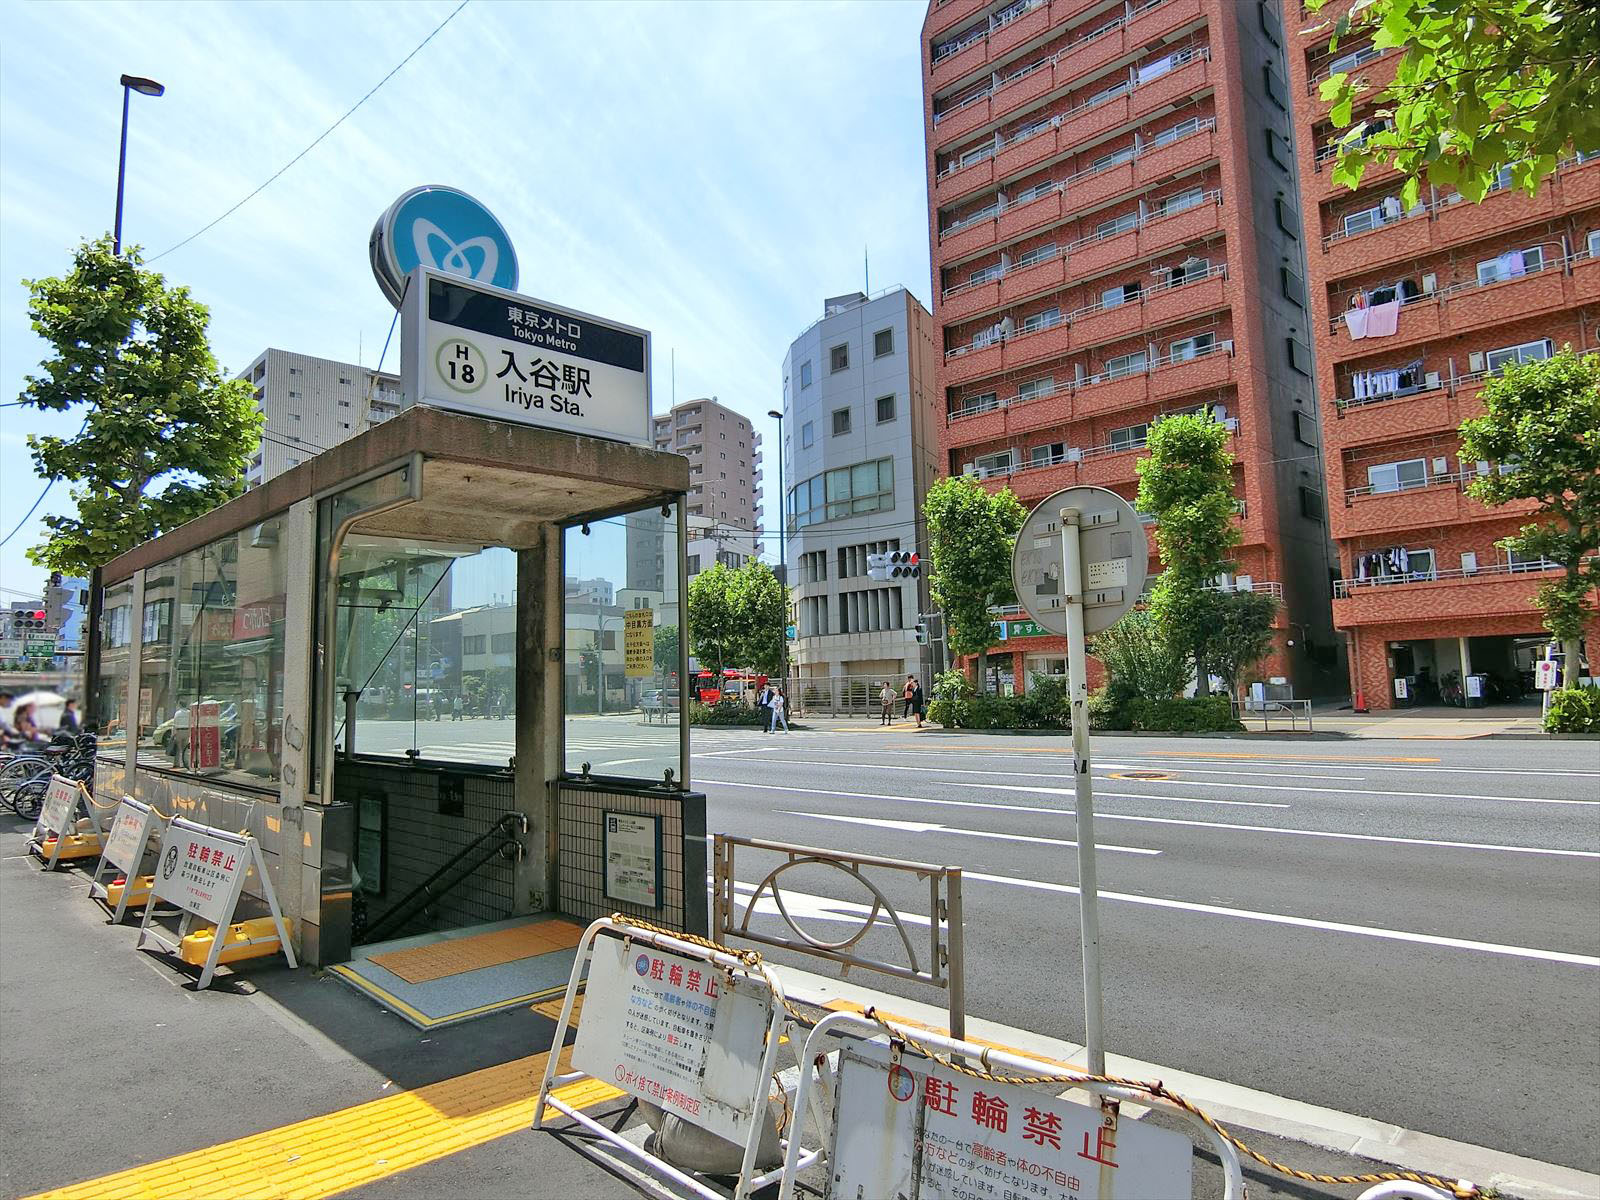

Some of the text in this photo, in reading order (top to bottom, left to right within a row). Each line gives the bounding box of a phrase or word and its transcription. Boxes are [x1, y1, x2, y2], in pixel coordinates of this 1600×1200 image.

[507, 306, 582, 339] 東京メトロ
[512, 325, 577, 352] Tokyo Metro
[456, 344, 469, 361] H
[448, 361, 476, 384] 18
[496, 349, 593, 399] 入谷駅
[505, 383, 585, 418] Iriya Sta.
[187, 842, 236, 872] 駐輪禁止
[649, 958, 719, 999] 駐輪禁止
[924, 1076, 1119, 1169] 駐輪禁止
